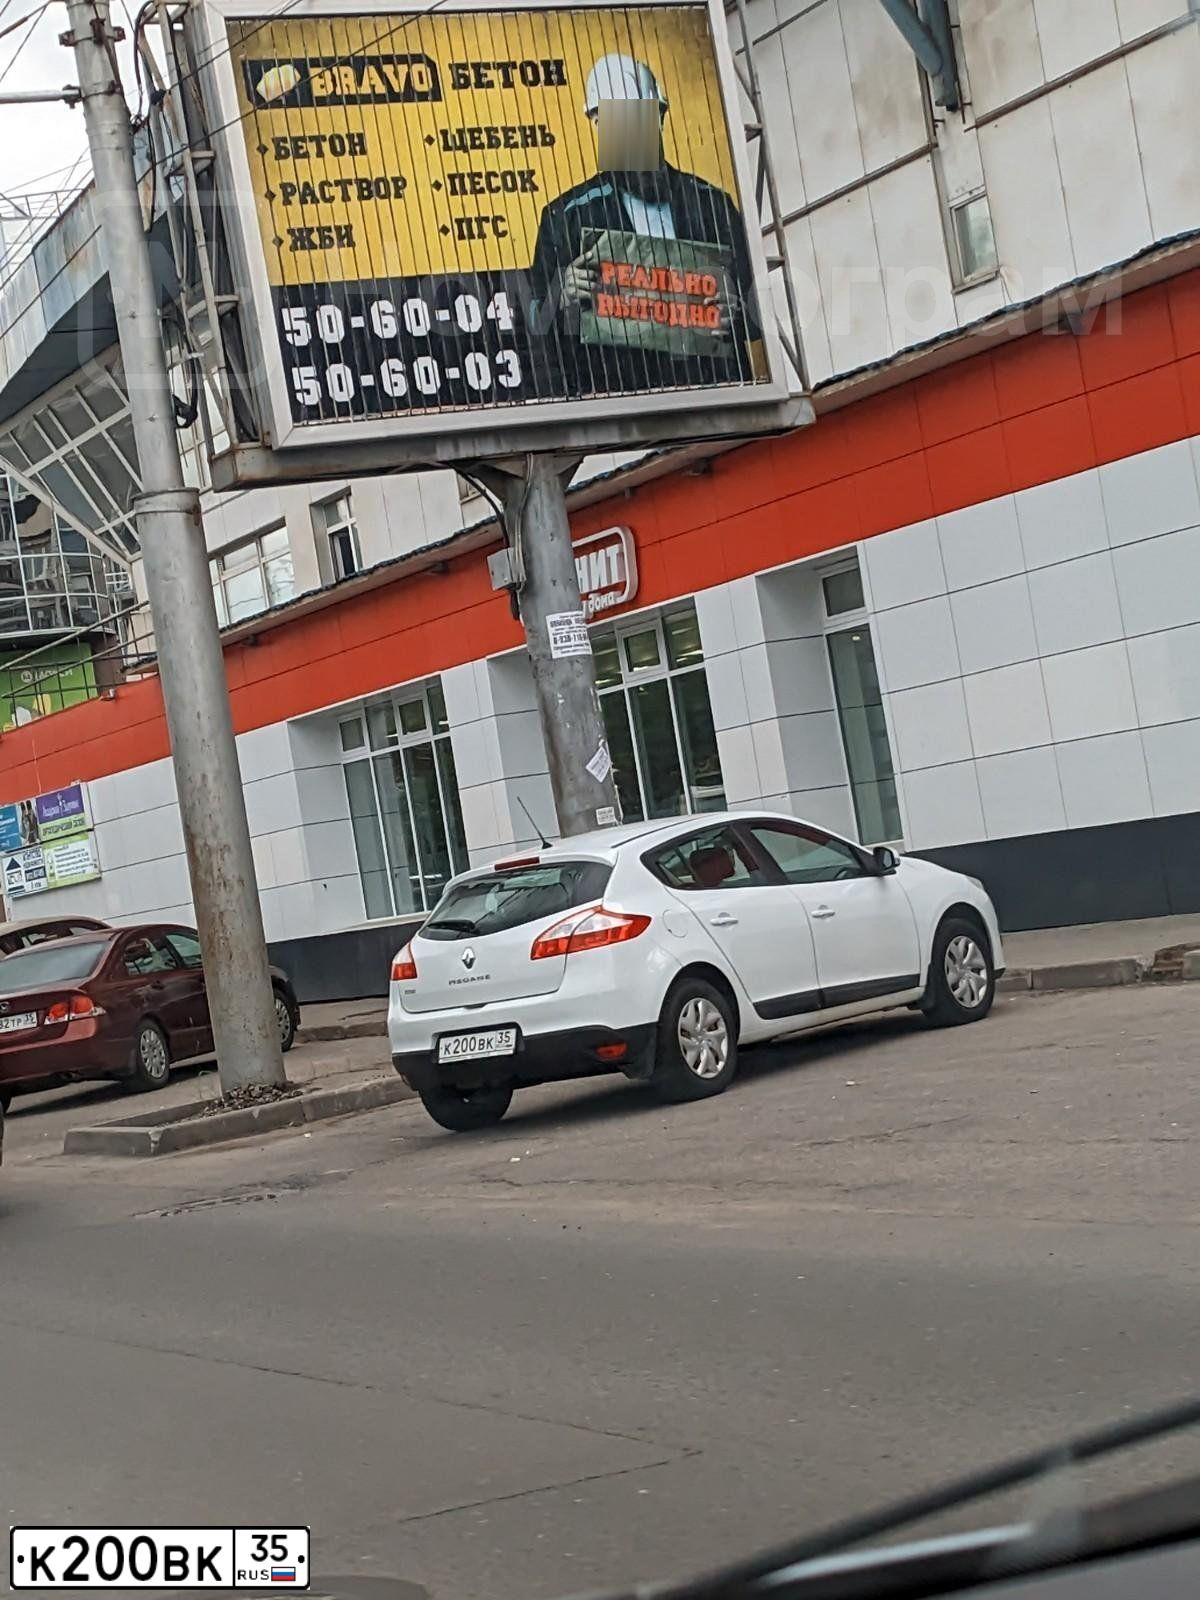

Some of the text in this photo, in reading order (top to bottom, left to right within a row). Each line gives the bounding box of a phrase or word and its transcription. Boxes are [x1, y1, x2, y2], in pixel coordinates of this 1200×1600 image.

[309, 59, 567, 97] BRAVO БЕТОН
[272, 132, 368, 160] БЕТОН
[440, 124, 556, 153] ЩЕБЕНЬ
[279, 176, 407, 206] РАСТВОР
[447, 169, 539, 196] ПЕСОК
[287, 222, 356, 252] ЖБИ
[455, 215, 508, 241] ПГС
[601, 261, 717, 297] РЕАЛЬНО
[281, 291, 514, 347] 50-60-04
[597, 292, 721, 329] ВЫГОДНО
[291, 349, 522, 406] 50-60-03
[574, 544, 622, 595] НИТ
[444, 1031, 512, 1056] К200ВК 35
